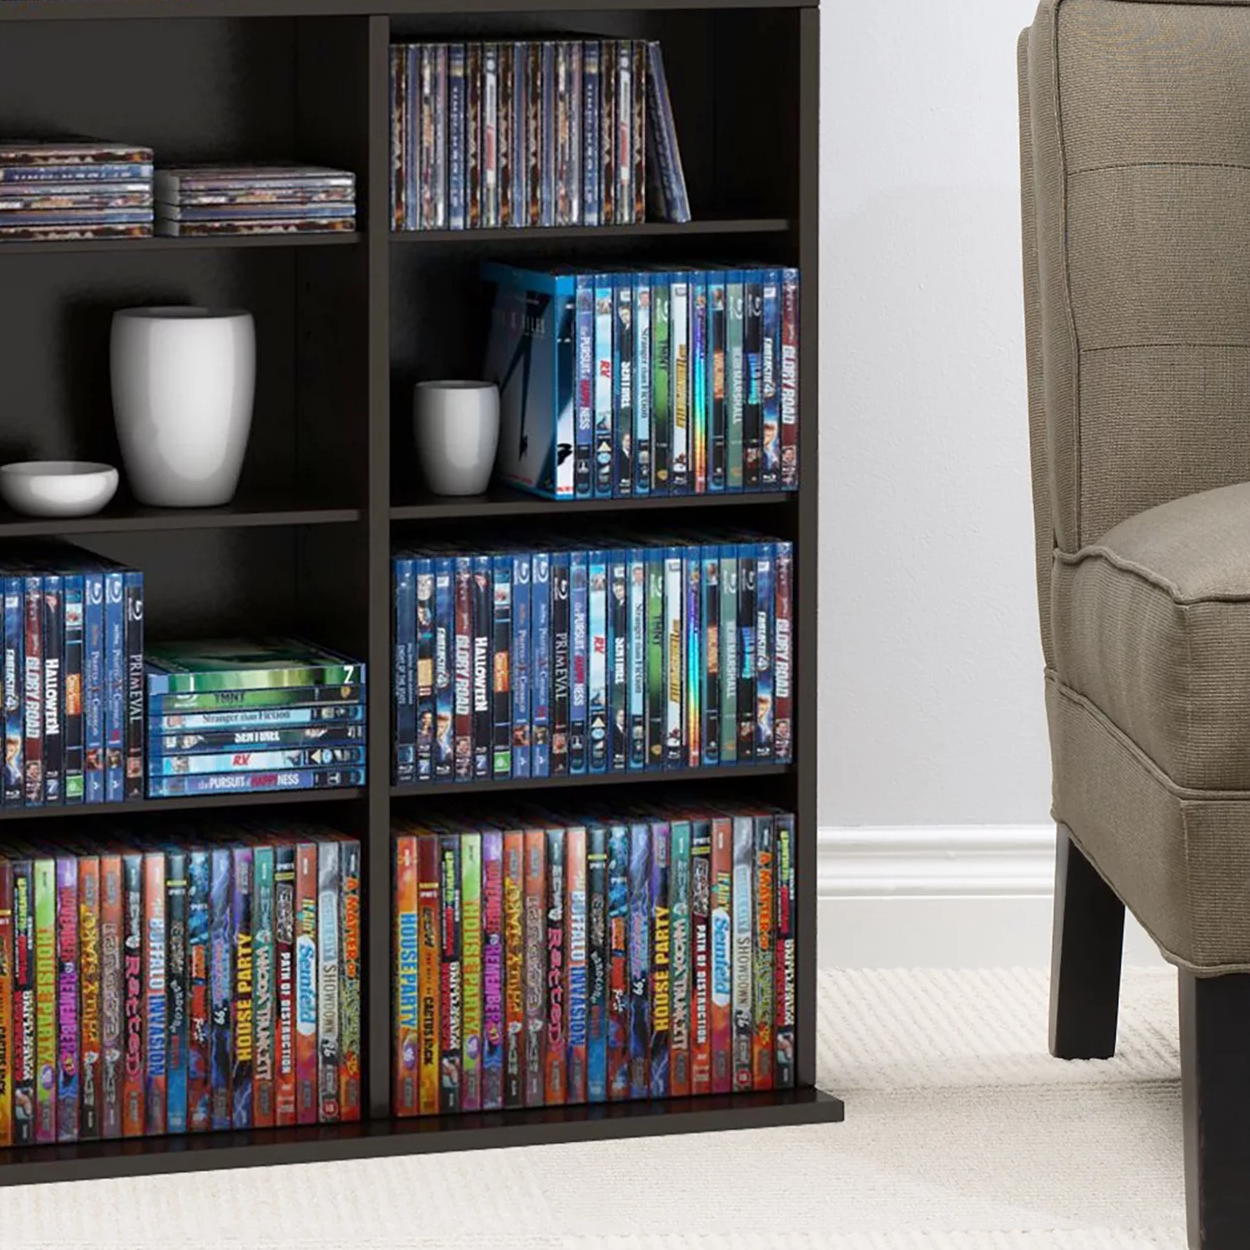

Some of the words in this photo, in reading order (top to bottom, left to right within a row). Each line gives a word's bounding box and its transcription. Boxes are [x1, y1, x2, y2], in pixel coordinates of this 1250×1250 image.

[781, 344, 797, 388] GLORY
[781, 389, 797, 425] ROAD
[455, 634, 470, 677] GLORY
[554, 632, 568, 703] PRIMEVAL
[775, 619, 791, 660] GLORY
[24, 656, 41, 700] GLORY
[44, 657, 60, 736] HALLOWEEN
[129, 654, 143, 725] PRIMEVAL
[455, 678, 470, 716] ROAD
[474, 636, 489, 712] HALLOWEEN
[775, 661, 791, 698] ROAD
[24, 701, 41, 739] ROAD
[345, 875, 360, 892] A
[758, 849, 773, 867] A
[345, 893, 360, 960] MATTER
[570, 889, 587, 961] BUFFALO
[758, 867, 773, 931] MATTER
[36, 930, 56, 994] HOUSE
[149, 916, 166, 990] BUFFALO
[236, 932, 252, 994] PARTY
[280, 951, 292, 979] PATH
[400, 911, 418, 969] HOUSE
[461, 902, 481, 967] HOUSE
[654, 904, 669, 965] PARTY
[696, 924, 707, 951] PATH
[696, 954, 707, 968] OF
[280, 982, 292, 997] OF
[321, 961, 338, 1036] SHOWDOWN
[400, 971, 418, 1030] PARTY
[484, 944, 502, 1022] REMEMBER
[654, 969, 669, 1031] HOUSE
[734, 934, 752, 1007] SHOWDOWN
[36, 999, 56, 1064] PARTY
[60, 972, 78, 1054] REMEMBER
[236, 1000, 252, 1062] HOUSE
[461, 972, 481, 1035] PARTY
[570, 964, 587, 1048] INVASION
[696, 971, 707, 1044] DESTRUCTION
[149, 993, 166, 1077] INVASION
[280, 999, 292, 1074] DESTRUCTION
